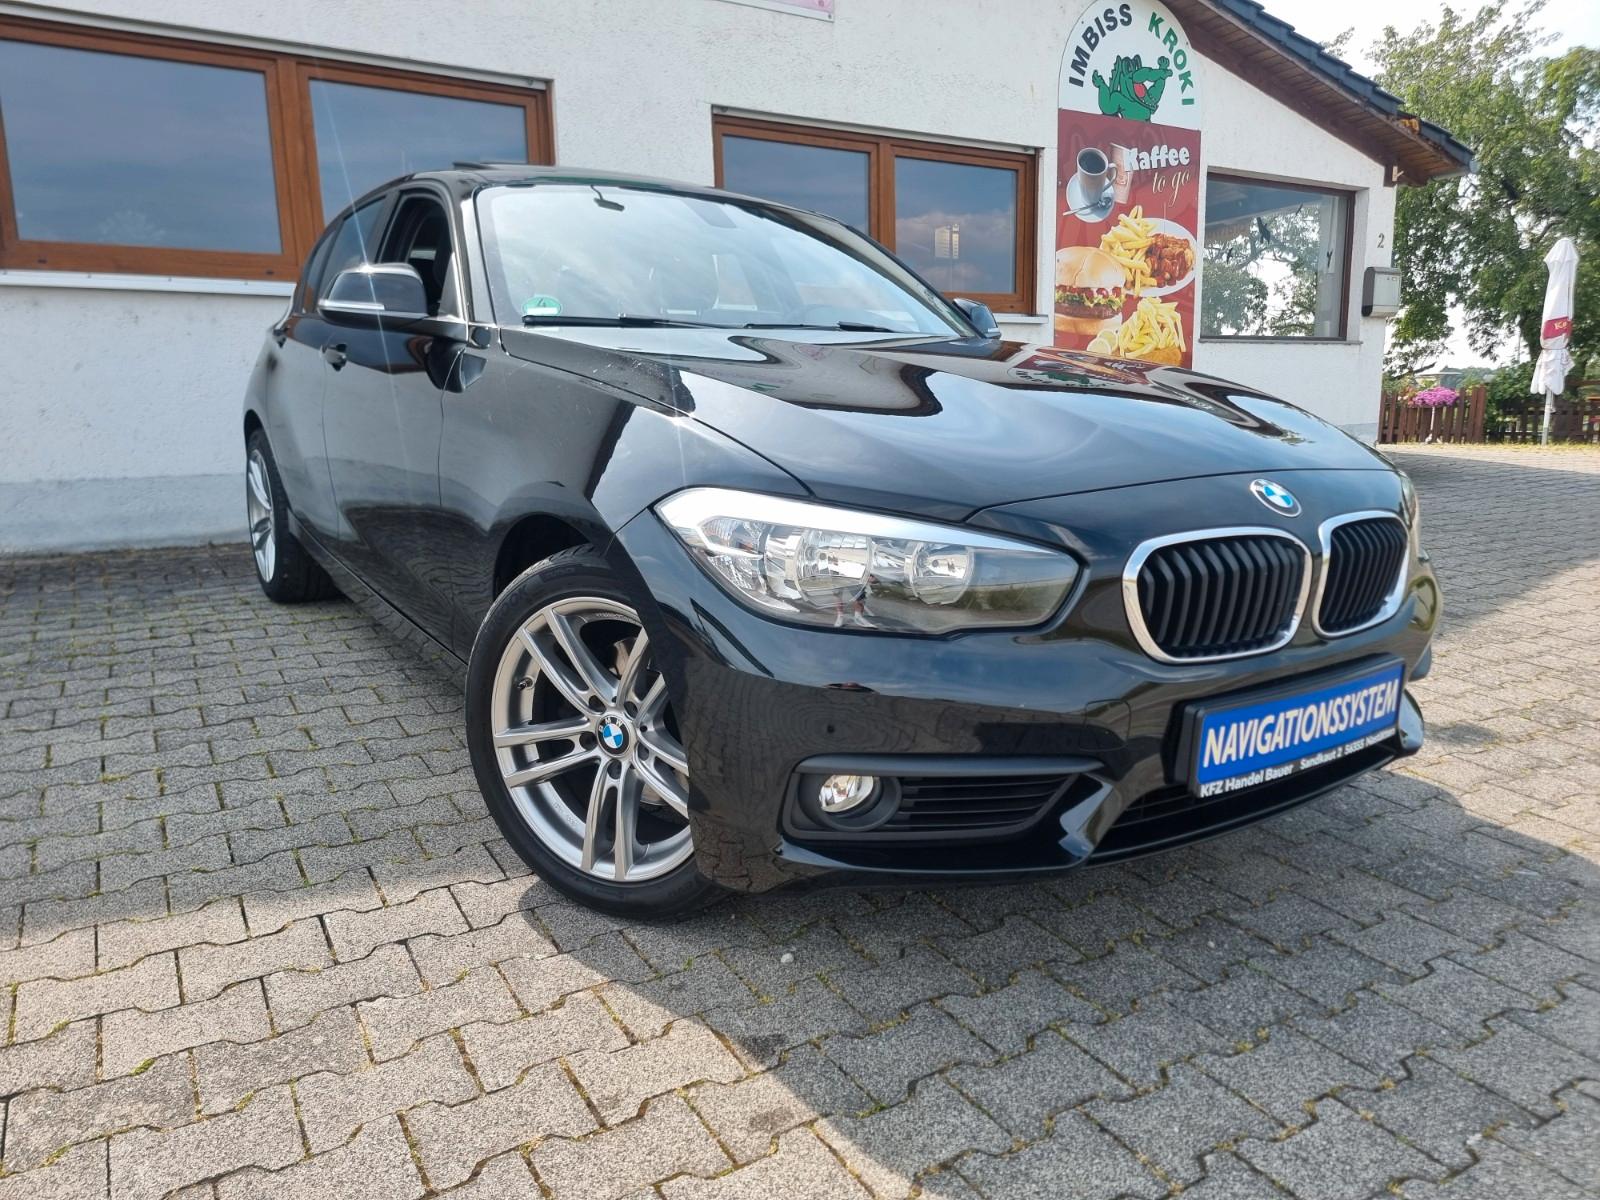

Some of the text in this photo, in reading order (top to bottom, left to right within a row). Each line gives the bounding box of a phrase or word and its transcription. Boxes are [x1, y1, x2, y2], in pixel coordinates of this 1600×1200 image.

[1068, 3, 1195, 105] IMBISS KROKI
[1123, 144, 1190, 172] Kaffee
[1152, 169, 1191, 207] to go
[1376, 232, 1385, 249] 2
[1202, 679, 1399, 768] NAVIGATIONSSYSTEM
[1200, 780, 1224, 798] KFZ
[1225, 769, 1265, 792] Handel
[1265, 764, 1294, 781] Bauer
